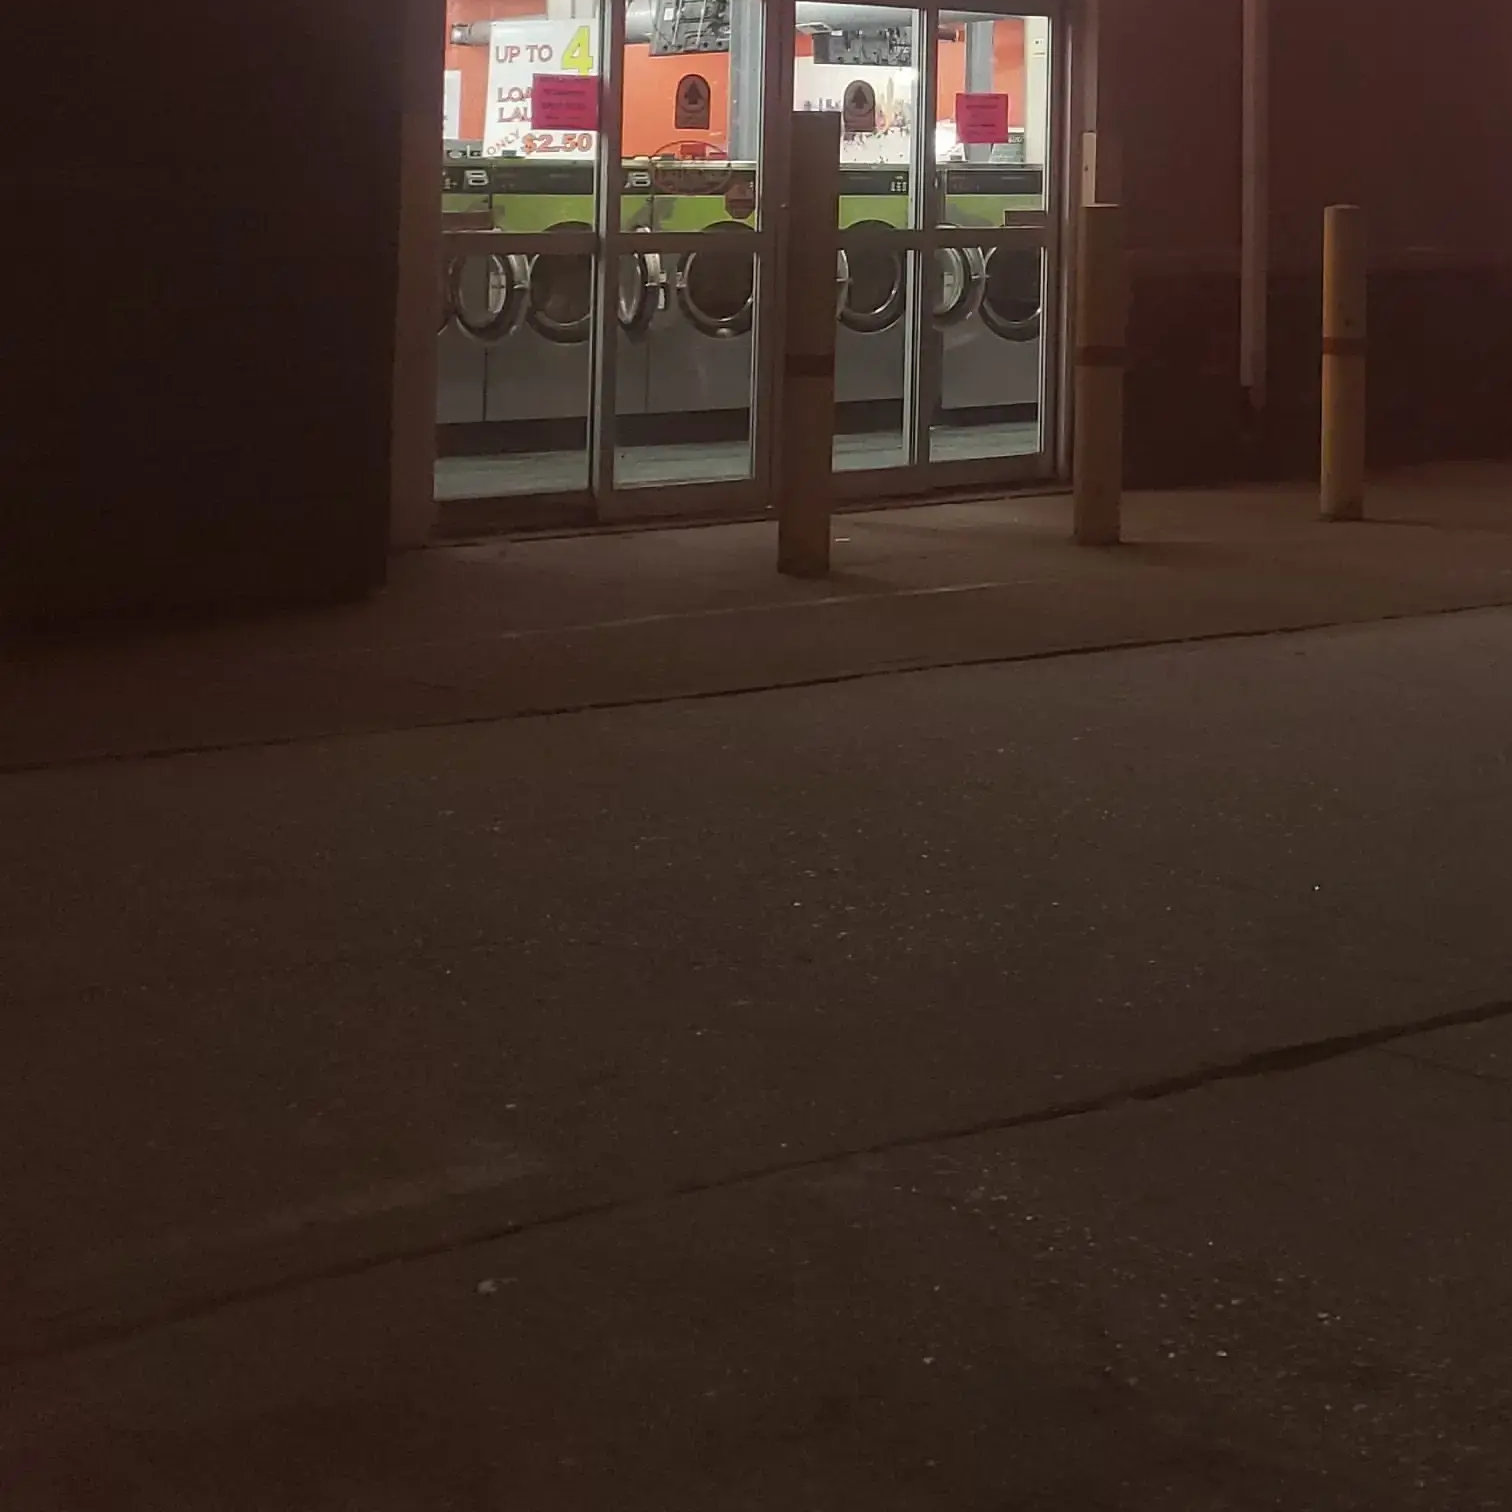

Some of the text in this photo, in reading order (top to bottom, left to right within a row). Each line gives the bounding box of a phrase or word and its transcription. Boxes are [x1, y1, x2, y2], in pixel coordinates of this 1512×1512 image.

[495, 25, 594, 76] UP TO 4
